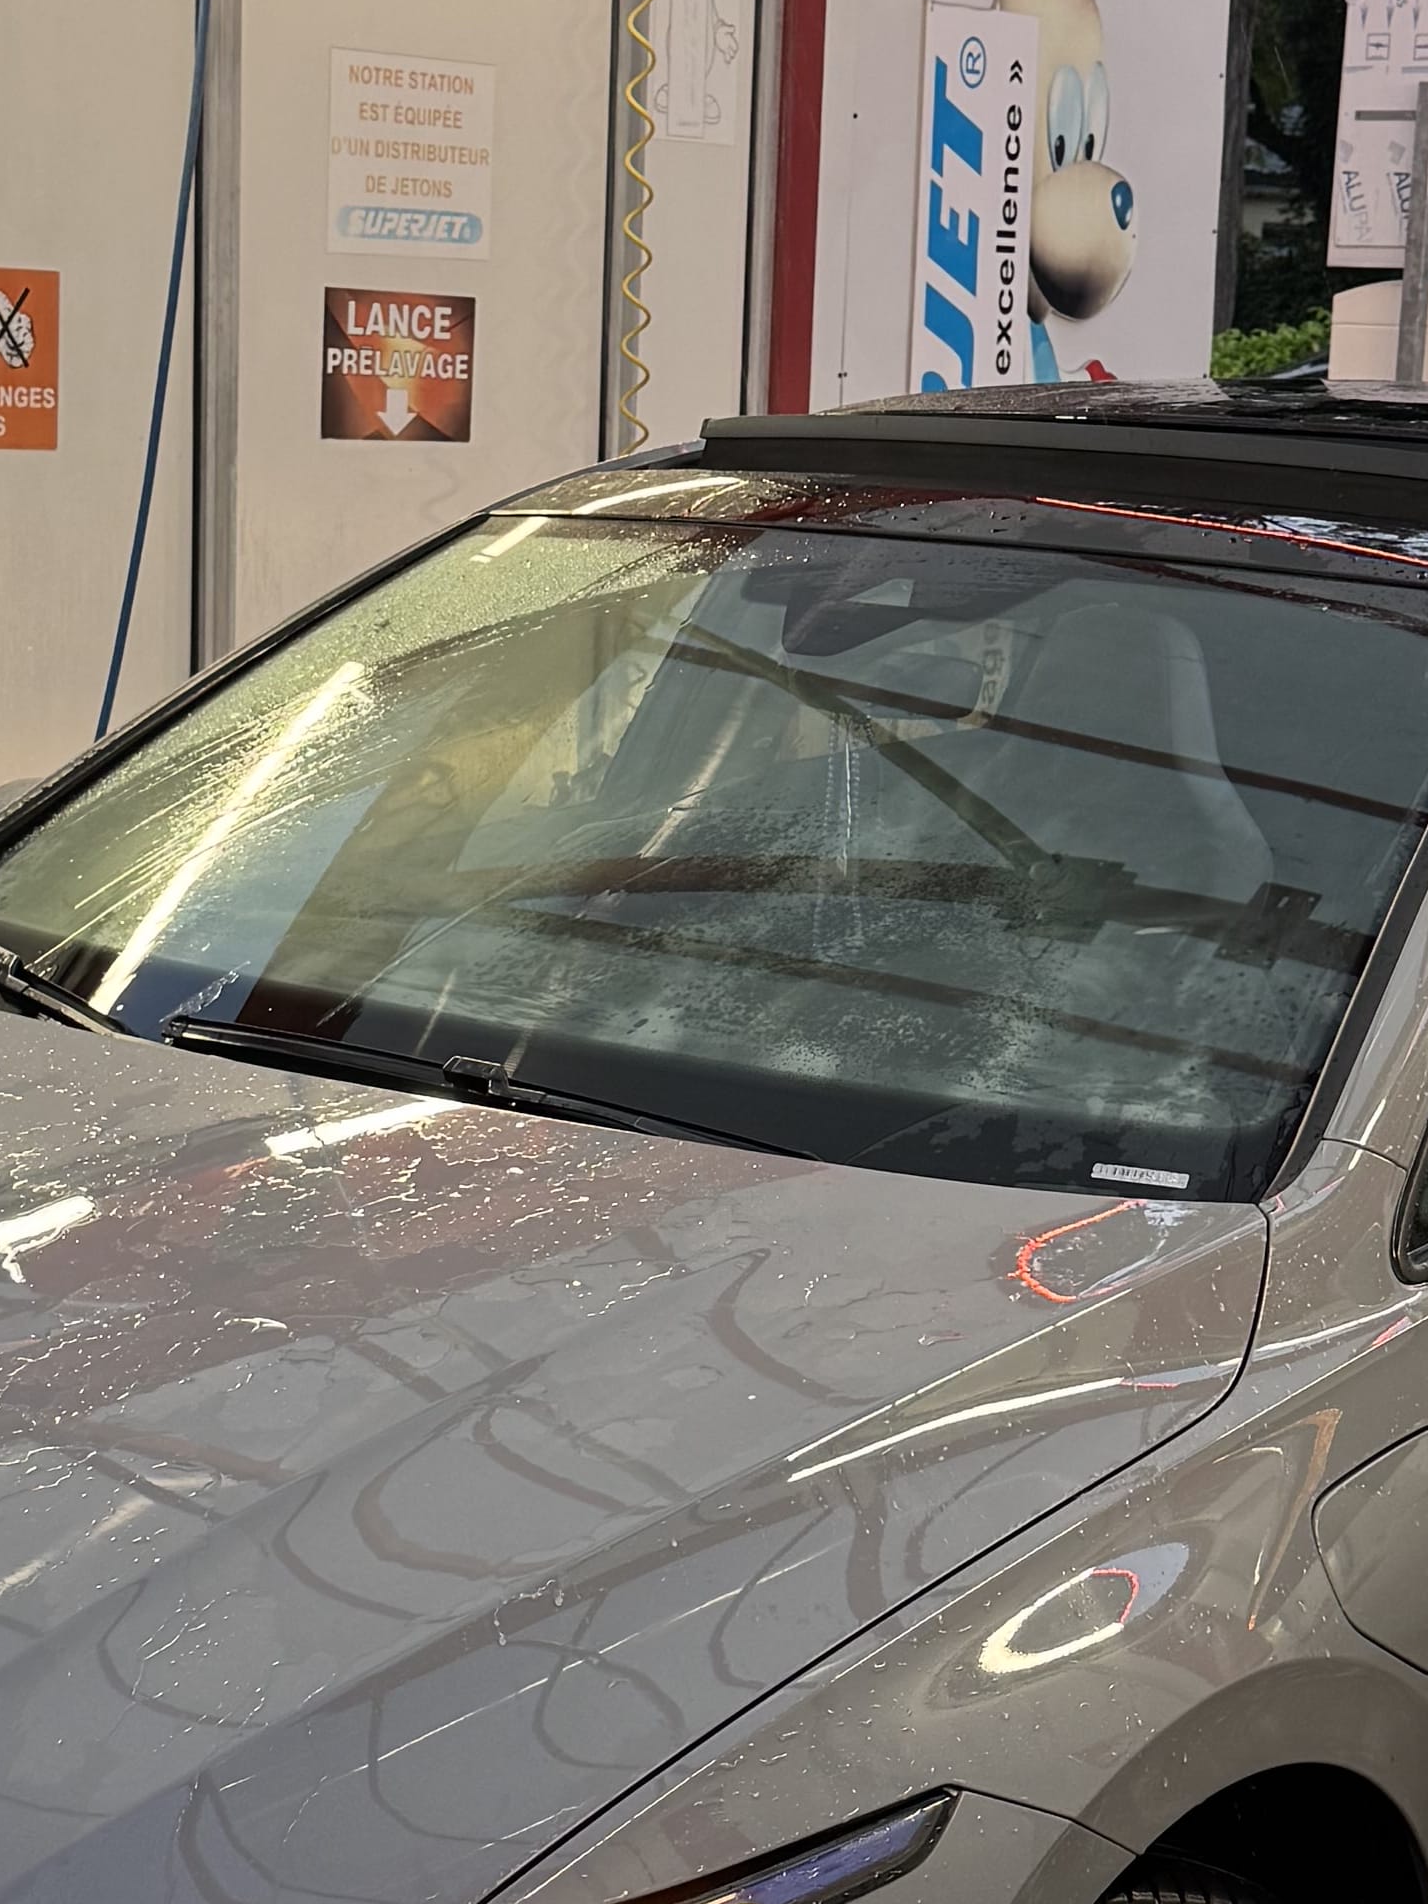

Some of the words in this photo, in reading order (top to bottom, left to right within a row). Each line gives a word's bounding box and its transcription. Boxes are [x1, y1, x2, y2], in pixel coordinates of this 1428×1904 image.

[348, 64, 404, 89] NOTRE
[408, 71, 475, 95] STATION
[358, 101, 390, 123] EST
[394, 100, 463, 130] ÉQUIPÉE
[331, 135, 370, 158] D'UN
[374, 139, 490, 166] DISTRIBUTEUR
[365, 174, 387, 194] DE
[391, 177, 453, 199] JETONS
[995, 104, 1022, 376] excellence
[346, 300, 453, 340] LANCE
